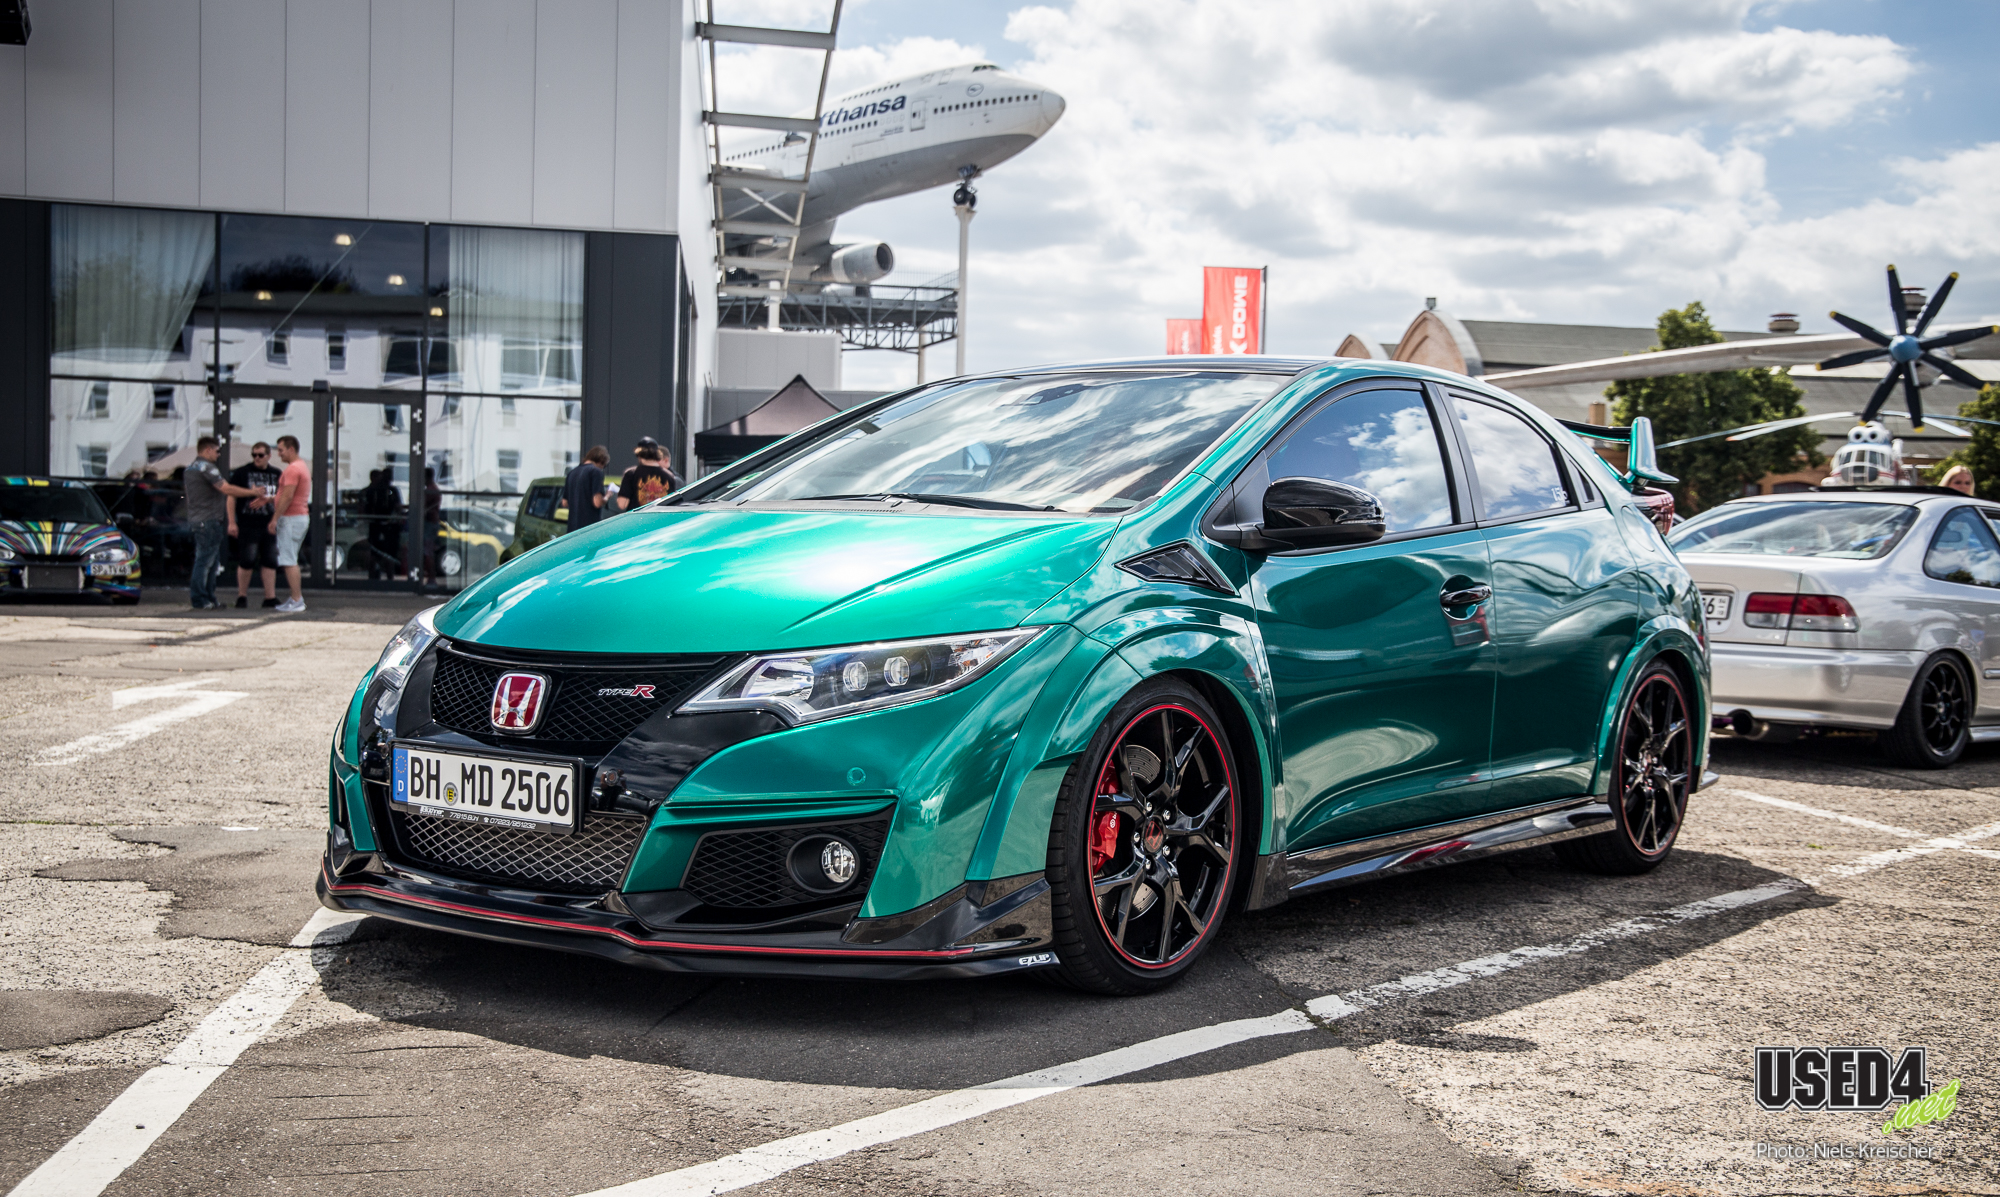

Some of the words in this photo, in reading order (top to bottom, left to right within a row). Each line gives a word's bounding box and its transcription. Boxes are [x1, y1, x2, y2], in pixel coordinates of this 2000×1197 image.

[819, 95, 907, 128] fthansa
[397, 779, 405, 792] D
[410, 756, 441, 800] BH
[461, 762, 494, 807] MD
[501, 767, 571, 817] 2506
